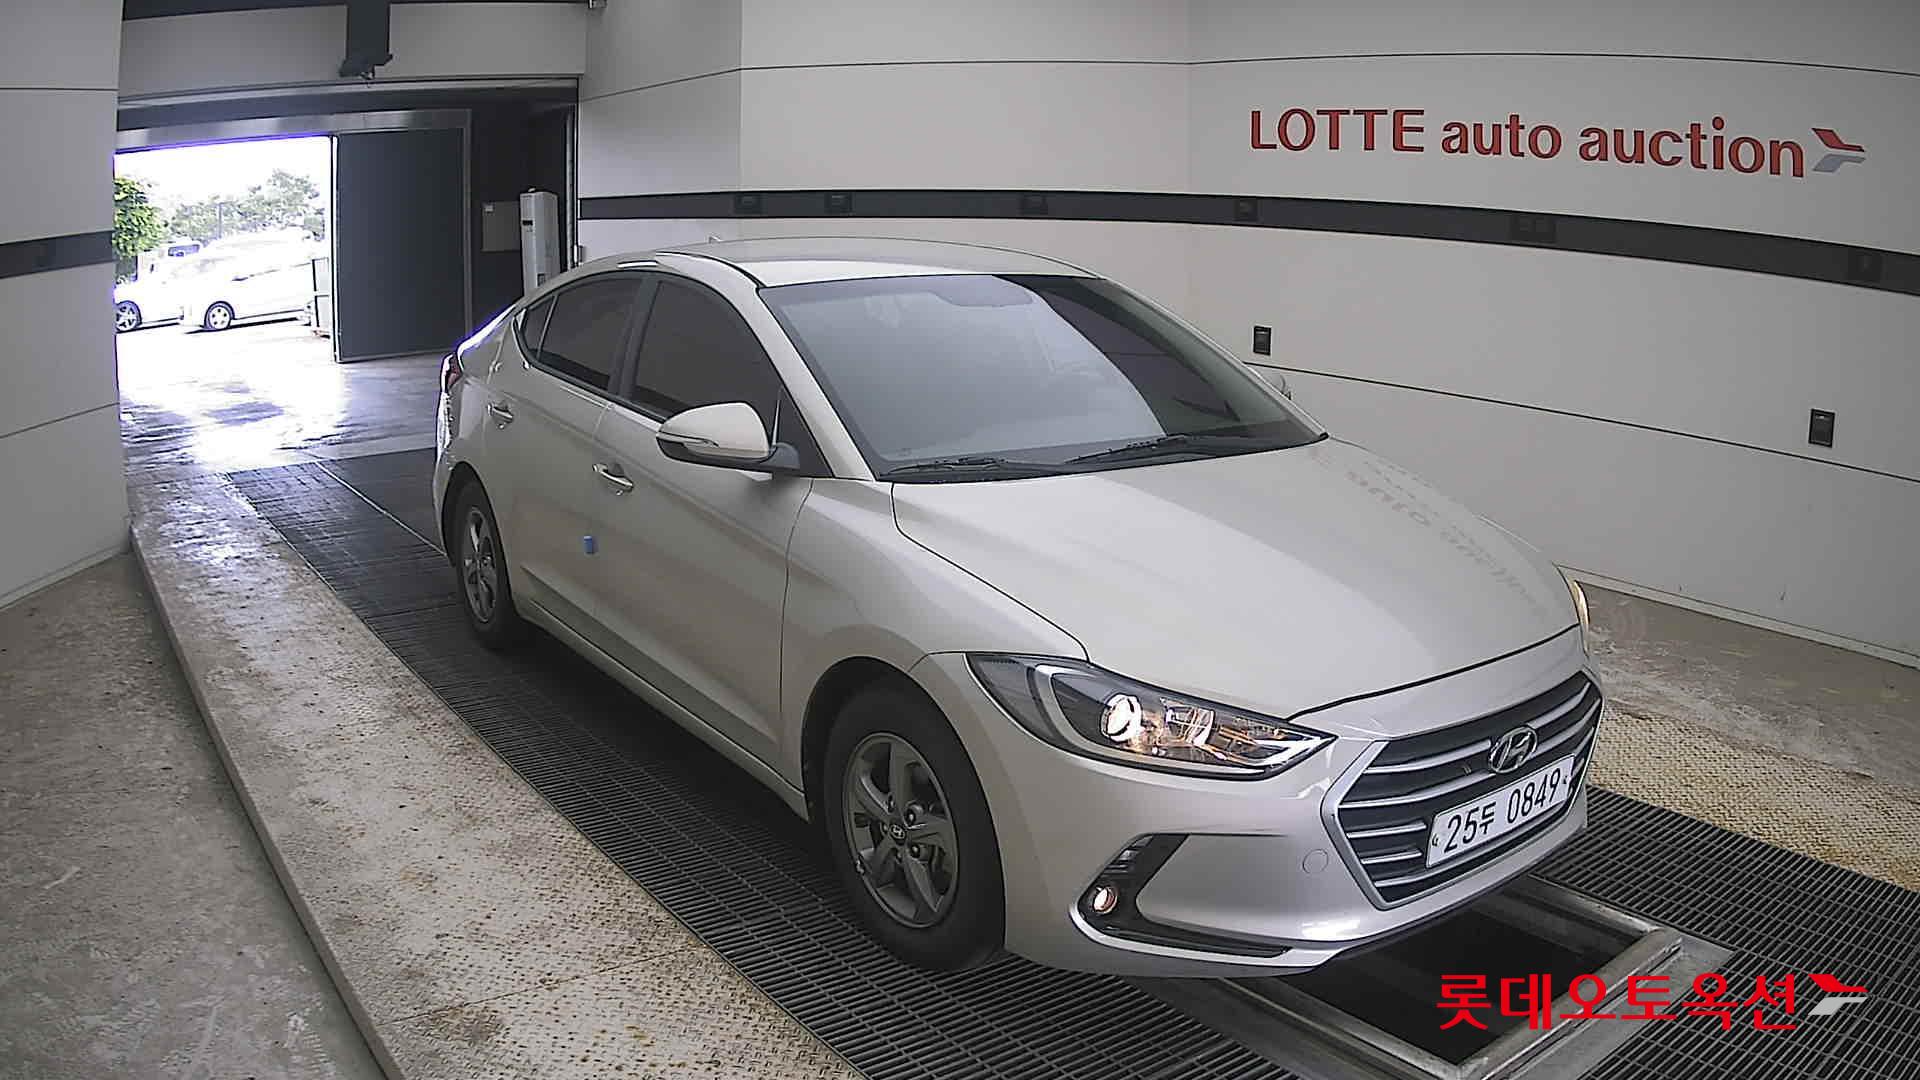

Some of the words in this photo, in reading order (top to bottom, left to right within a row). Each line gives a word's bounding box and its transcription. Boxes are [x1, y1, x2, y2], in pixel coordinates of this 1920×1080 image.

[1250, 109, 1425, 152] LOTTE
[1441, 113, 1562, 159] auto
[1579, 116, 1804, 177] auction
[1443, 801, 1497, 853] 25두
[1506, 767, 1561, 824] 0849
